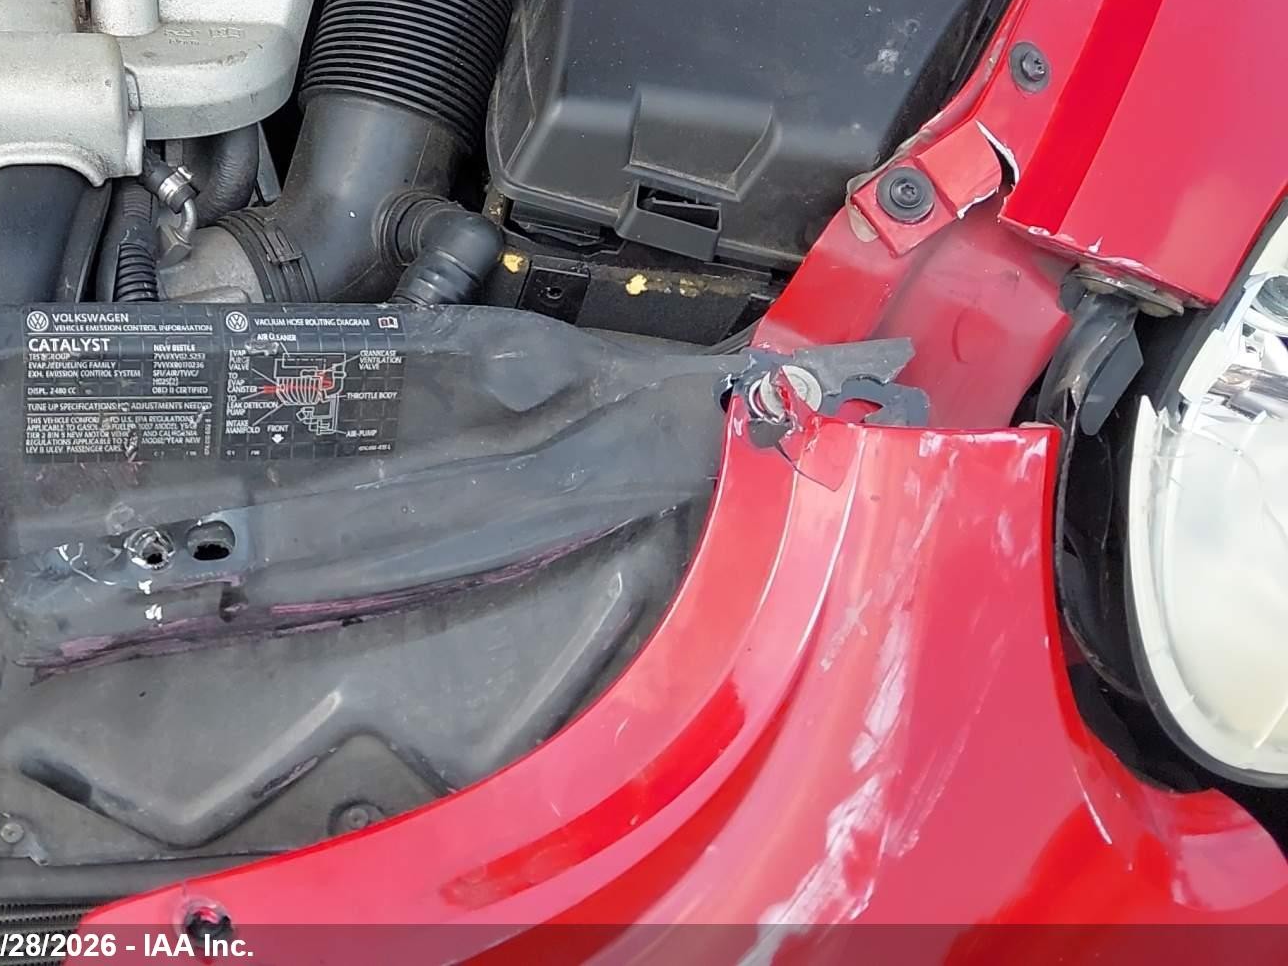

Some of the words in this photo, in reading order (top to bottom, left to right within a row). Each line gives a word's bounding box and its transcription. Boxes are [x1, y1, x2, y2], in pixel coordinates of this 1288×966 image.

[52, 313, 129, 323] VOLKSWAGEN
[255, 318, 286, 326] VACUUM
[286, 318, 304, 326] HOSE
[305, 318, 336, 326] ROUTING
[337, 318, 371, 326] DIAGRAM
[54, 324, 85, 332] VEHICLE
[85, 324, 122, 332] EMISSION
[158, 324, 213, 332] INFORMATION
[28, 337, 111, 352] CATALYST
[153, 344, 171, 352] NEW
[88, 361, 116, 370] FAMILY
[27, 402, 47, 411] TUNE
[47, 402, 59, 411] UP
[130, 402, 183, 411] ADJUSTMENTS
